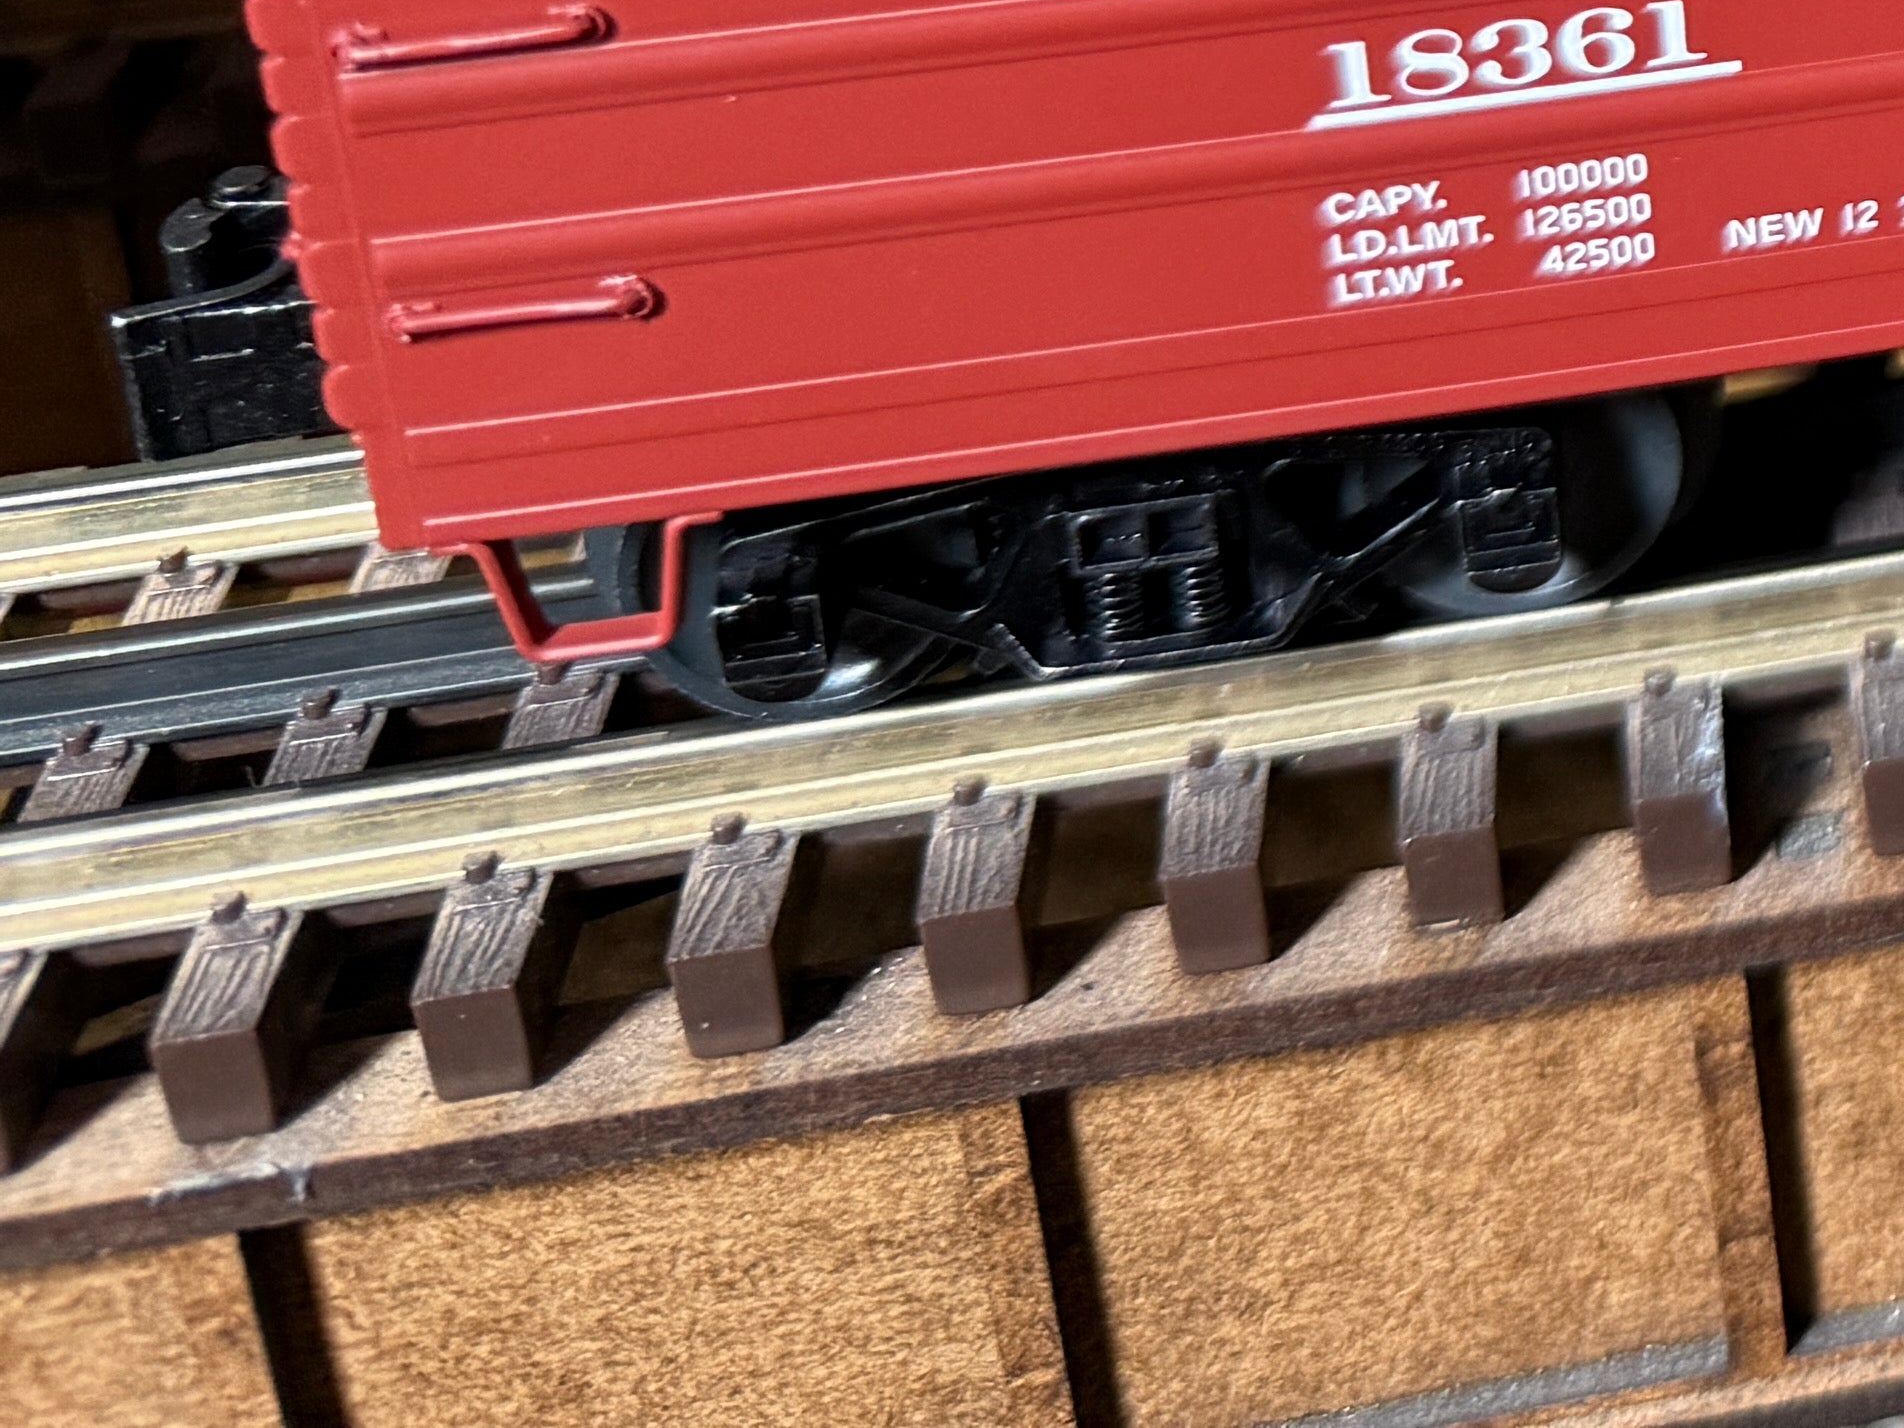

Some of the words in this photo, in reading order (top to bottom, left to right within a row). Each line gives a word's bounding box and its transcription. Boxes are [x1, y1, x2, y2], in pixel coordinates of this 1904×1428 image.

[1320, 0, 1709, 112] 18361
[1317, 180, 1448, 228] CAPY.
[1515, 153, 1649, 202] 100000
[1722, 207, 1824, 252] NEW
[1840, 199, 1879, 236] 12
[1322, 214, 1495, 269] LD.LMT.
[1518, 192, 1653, 242] 126500
[1327, 258, 1465, 310] LT.WT.
[1534, 232, 1656, 277] 42500
